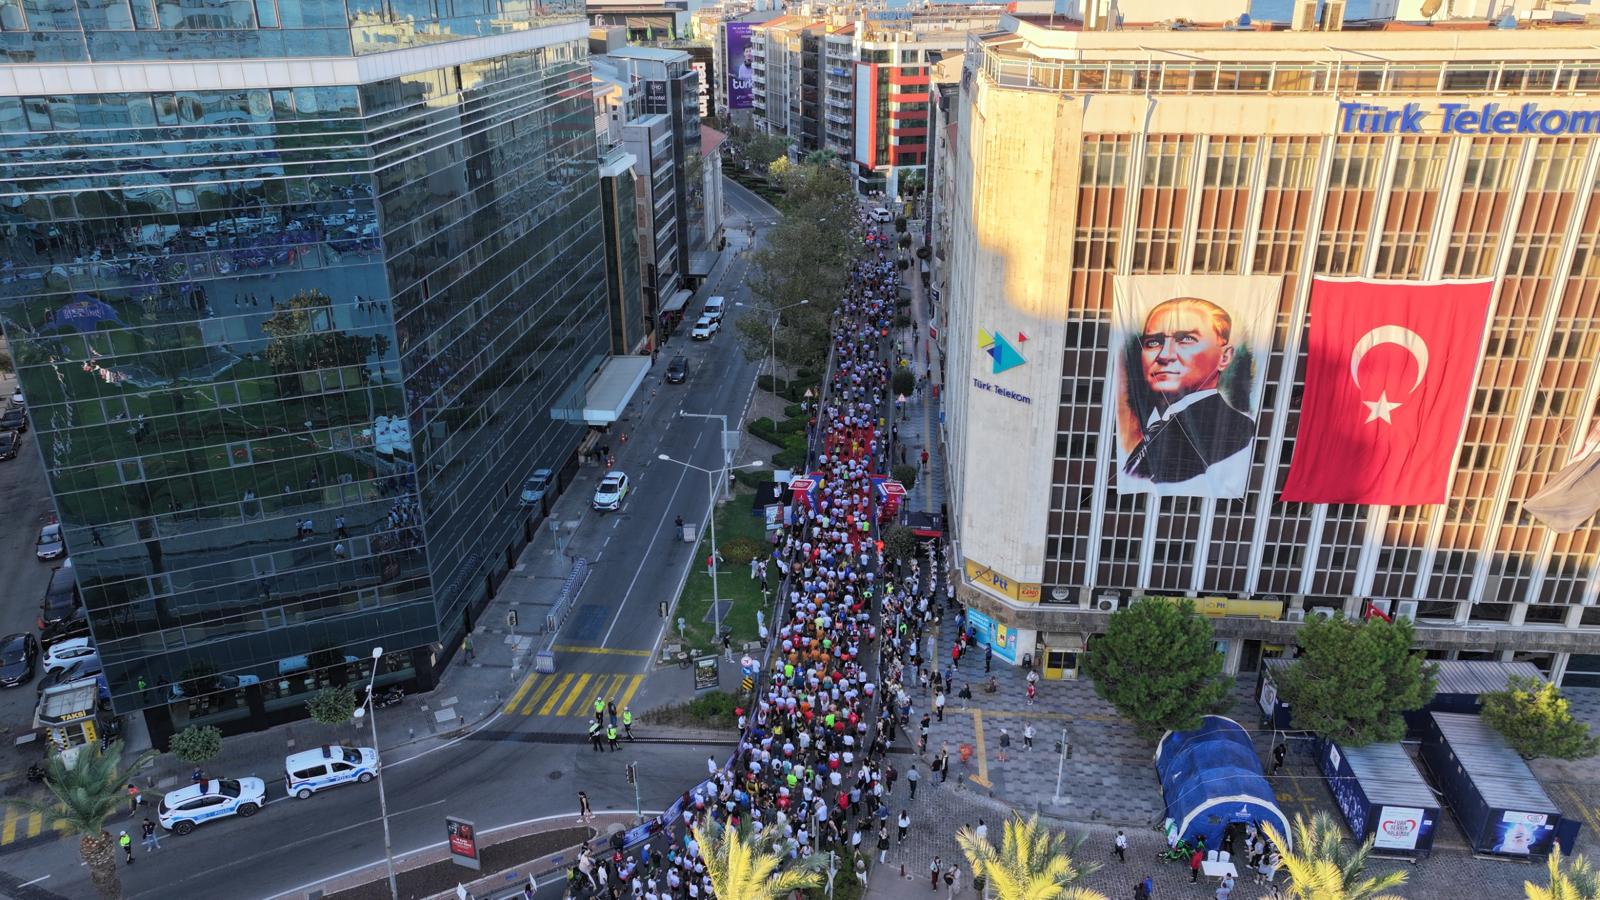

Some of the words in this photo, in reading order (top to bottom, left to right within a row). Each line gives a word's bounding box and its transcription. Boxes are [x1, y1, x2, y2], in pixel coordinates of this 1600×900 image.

[1340, 102, 1426, 134] Türk
[1439, 102, 1600, 135] Telekom
[973, 378, 991, 392] Türk
[994, 384, 1031, 404] Telekom
[993, 574, 1008, 591] Ptt
